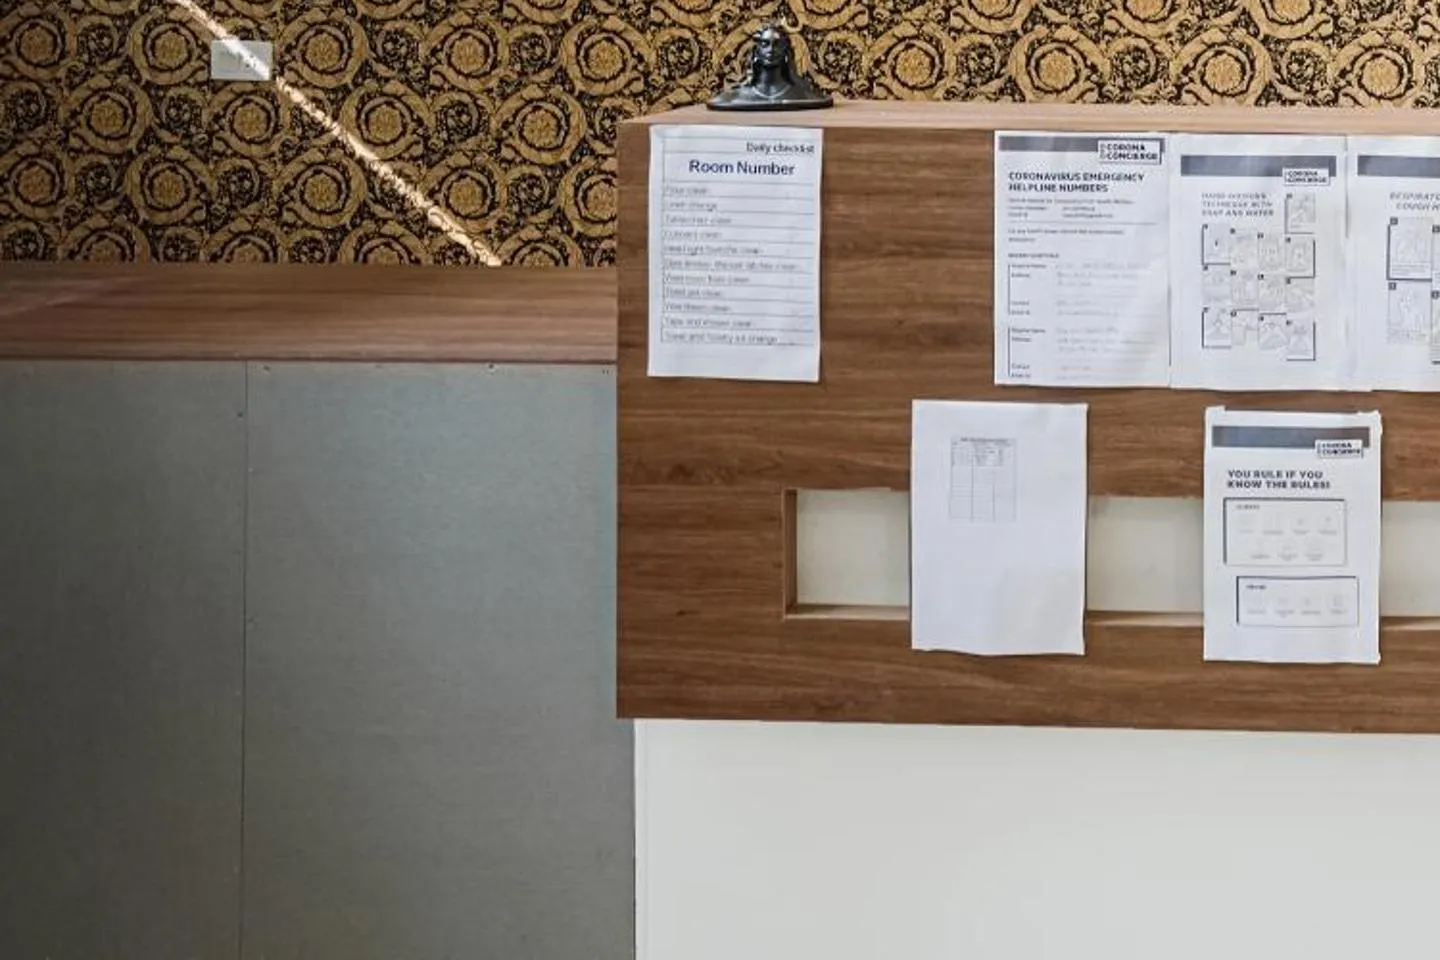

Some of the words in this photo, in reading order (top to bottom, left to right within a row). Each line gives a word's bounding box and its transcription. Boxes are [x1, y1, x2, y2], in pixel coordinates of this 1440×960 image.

[689, 159, 734, 174] Room
[737, 161, 795, 176] Number
[1008, 172, 1081, 182] CORONAVIRUS
[1083, 172, 1145, 182] EMERGENCY
[1008, 183, 1057, 193] HELPLINE
[1059, 183, 1109, 193] NUMBERS
[1228, 469, 1251, 479] YOU
[1253, 470, 1283, 479] RULE
[1285, 470, 1296, 479] IF
[1299, 470, 1324, 480] YOU
[1227, 479, 1263, 489] KNOW
[1265, 480, 1288, 489] THE
